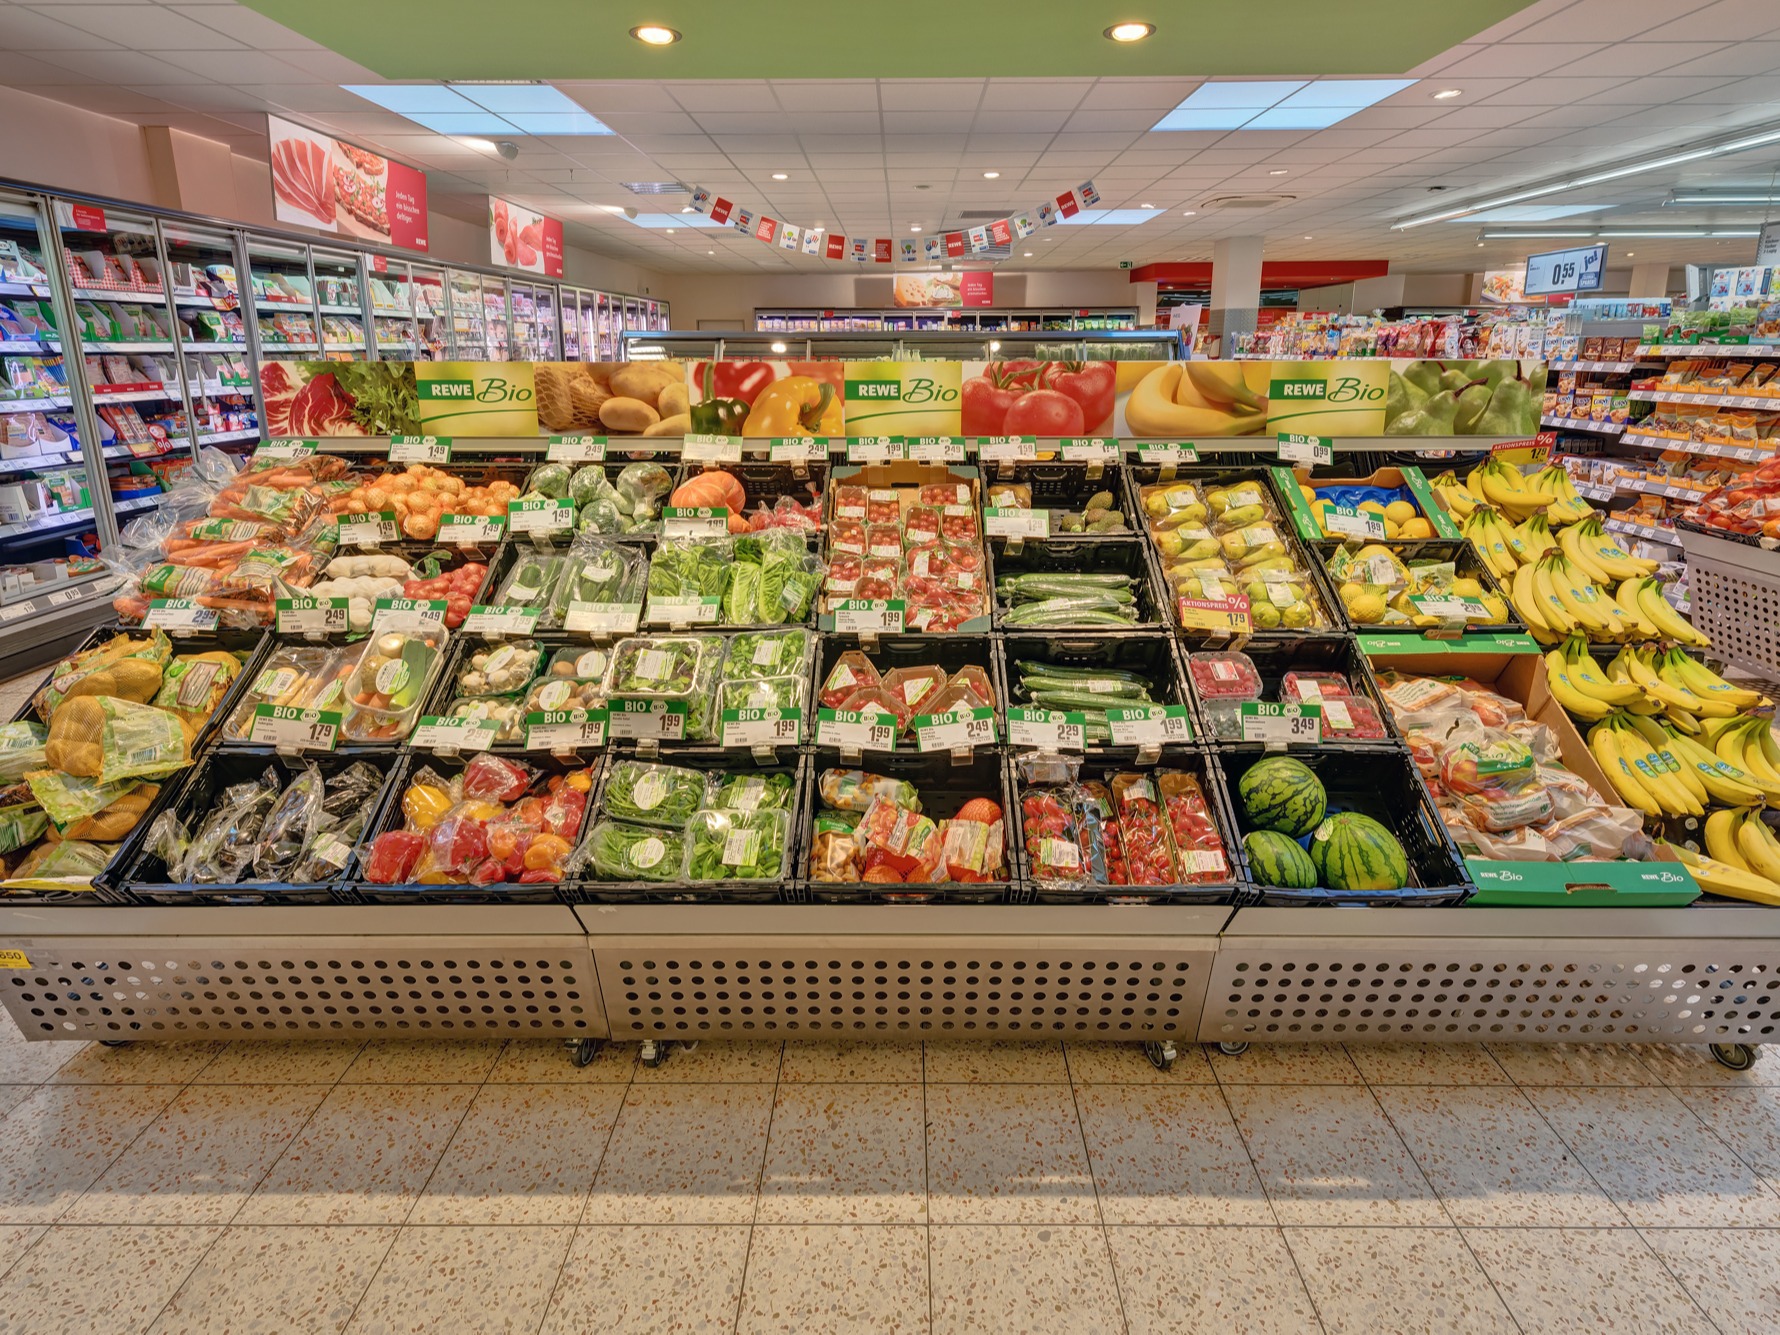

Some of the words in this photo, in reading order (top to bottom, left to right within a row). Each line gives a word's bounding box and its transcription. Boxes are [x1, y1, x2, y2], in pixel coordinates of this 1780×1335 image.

[1061, 201, 1075, 210] REWE
[715, 206, 728, 216] REWE
[1584, 250, 1598, 271] ja!
[1552, 262, 1575, 286] 0.55
[431, 384, 472, 397] REWE
[476, 378, 532, 403] Bio
[858, 384, 898, 397] REWE
[902, 378, 958, 404] Bio
[1283, 383, 1324, 396] REWE
[1327, 377, 1385, 403] Bio
[403, 436, 420, 444] BIO
[561, 437, 578, 445] BIO
[696, 435, 713, 443] BIO
[782, 438, 798, 446] BIO
[858, 437, 874, 445] BIO
[919, 437, 935, 445] BIO
[989, 436, 1006, 444] BIO
[1072, 439, 1088, 447] BIO
[1289, 434, 1305, 443] BIO
[1493, 440, 1536, 450] AKTIONSPREIS
[1530, 447, 1547, 459] 1.79
[523, 502, 540, 510] BIO
[552, 510, 569, 522] 1.49
[1337, 507, 1353, 516] BIO
[349, 514, 365, 522] BIO
[453, 516, 472, 524] BIO
[377, 522, 393, 535] 1.49
[482, 525, 499, 535] 1.49
[1365, 521, 1381, 533] 1.89
[165, 600, 186, 608] BIO
[292, 599, 312, 609] BIO
[391, 600, 411, 609] BIO
[849, 601, 868, 609] BIO
[1182, 600, 1229, 609] AKTIONSPREIS
[192, 610, 217, 623] 2.99
[325, 610, 344, 623] 2.49
[881, 612, 899, 626] 1.99
[1227, 613, 1245, 626] 1.79
[625, 701, 646, 711] BIO
[1258, 705, 1279, 715] BIO
[273, 707, 297, 718] BIO
[739, 710, 759, 720] BIO
[835, 711, 856, 721] BIO
[1024, 711, 1045, 721] BIO
[1123, 710, 1144, 720] BIO
[436, 717, 459, 726] BIO
[544, 713, 566, 723] BIO
[659, 715, 680, 730] 1.99
[931, 714, 953, 725] BIO
[580, 723, 601, 738] 1.99
[774, 721, 795, 736] 1.99
[967, 721, 989, 737] 2.49
[1160, 719, 1183, 734] 1.99
[1292, 718, 1314, 734] 3.49
[309, 723, 332, 740] 1.79
[869, 726, 890, 741] 1.99
[1058, 725, 1079, 739] 2.29
[1499, 870, 1523, 881] Bio
[1660, 872, 1684, 882] Bio
